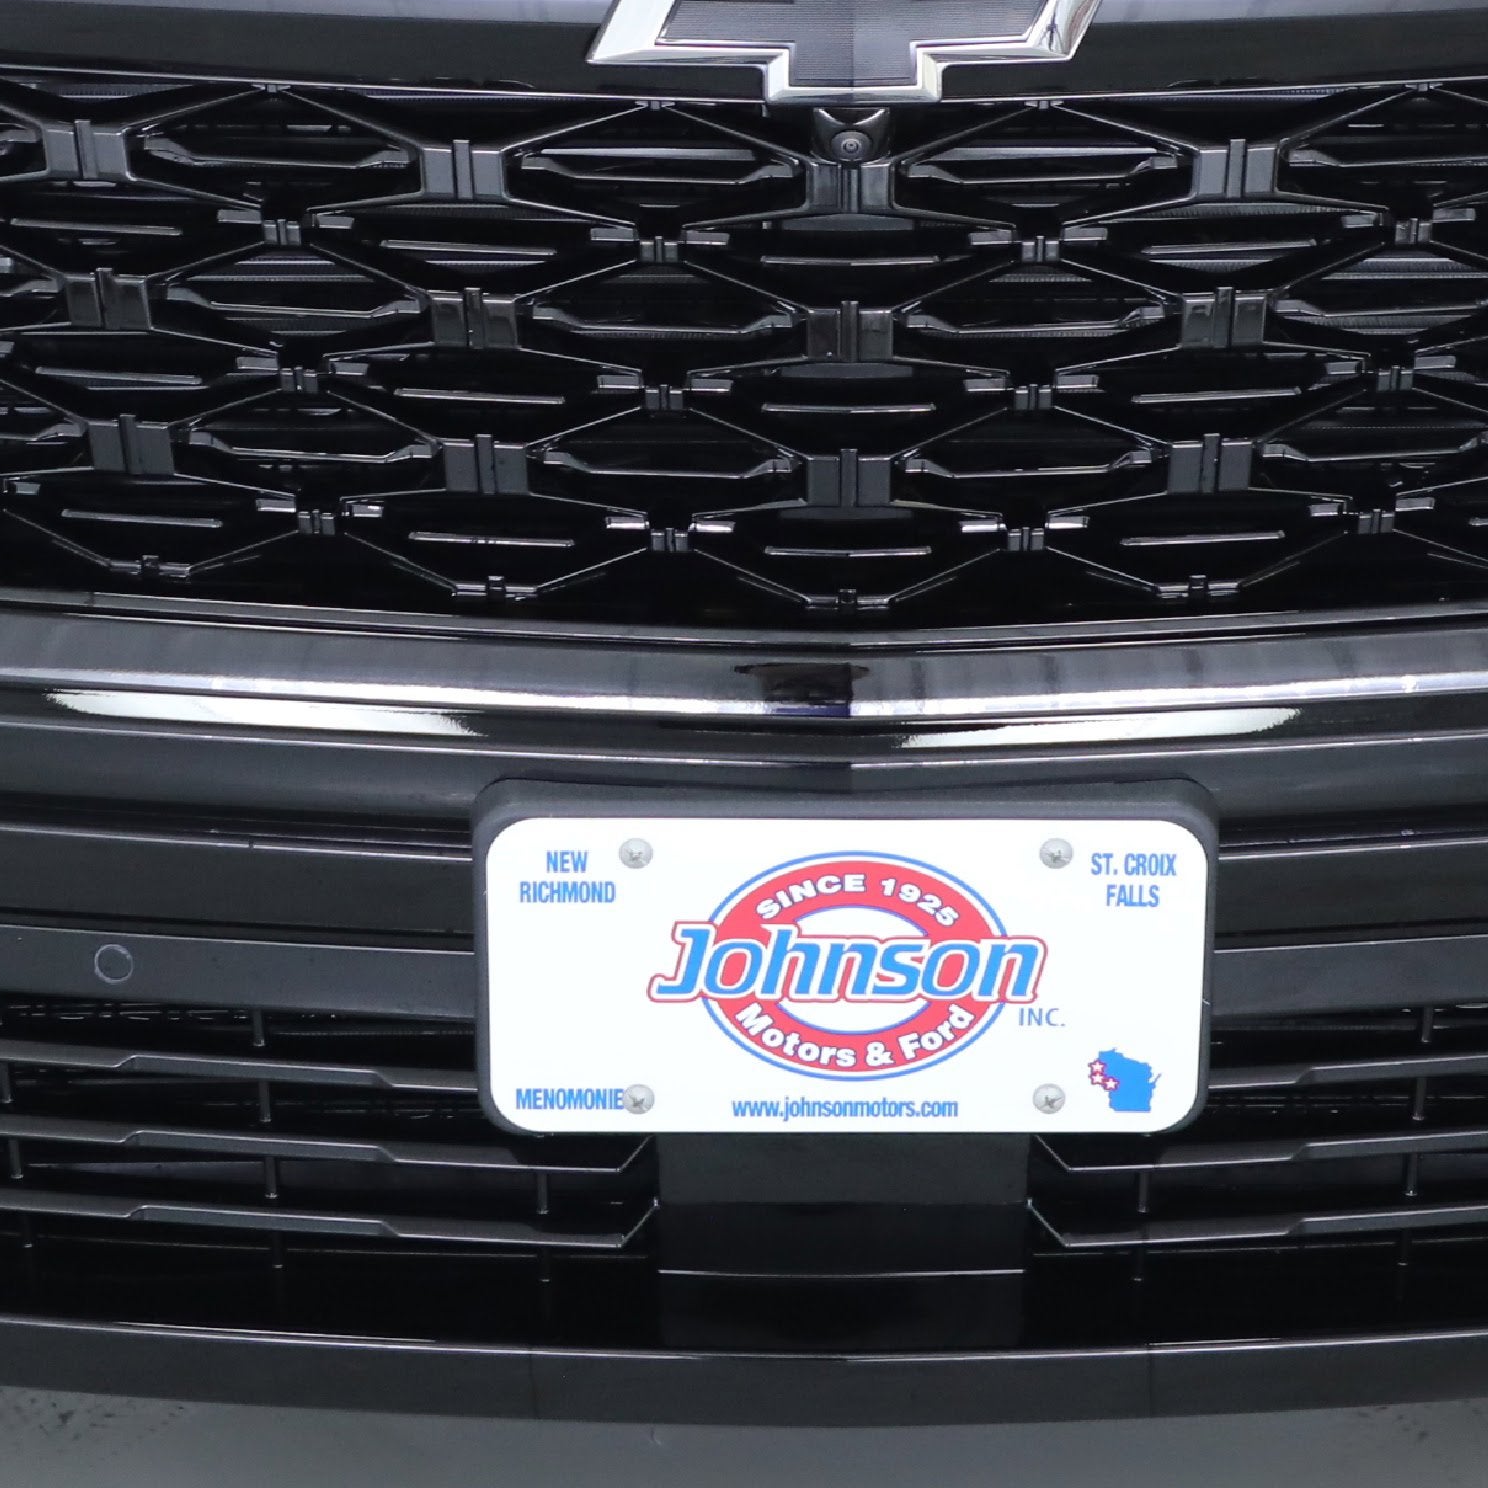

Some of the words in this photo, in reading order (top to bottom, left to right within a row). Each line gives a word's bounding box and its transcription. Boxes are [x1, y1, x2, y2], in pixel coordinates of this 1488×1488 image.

[545, 850, 588, 873] NEW
[1090, 852, 1118, 875] ST.
[1123, 853, 1177, 876] CROIX
[519, 881, 616, 903] RICHMOND
[756, 873, 866, 920] SINCE
[879, 878, 960, 926] 1925
[1106, 884, 1160, 907] FALLS
[651, 924, 1042, 999] Johnson
[1017, 1007, 1066, 1027] INC.
[734, 1001, 857, 1068] Motors
[865, 1041, 896, 1067] &
[897, 1002, 975, 1061] Ford
[515, 1087, 625, 1110] MENOMONIE
[731, 1096, 959, 1121] www.johnsonmotors.com
